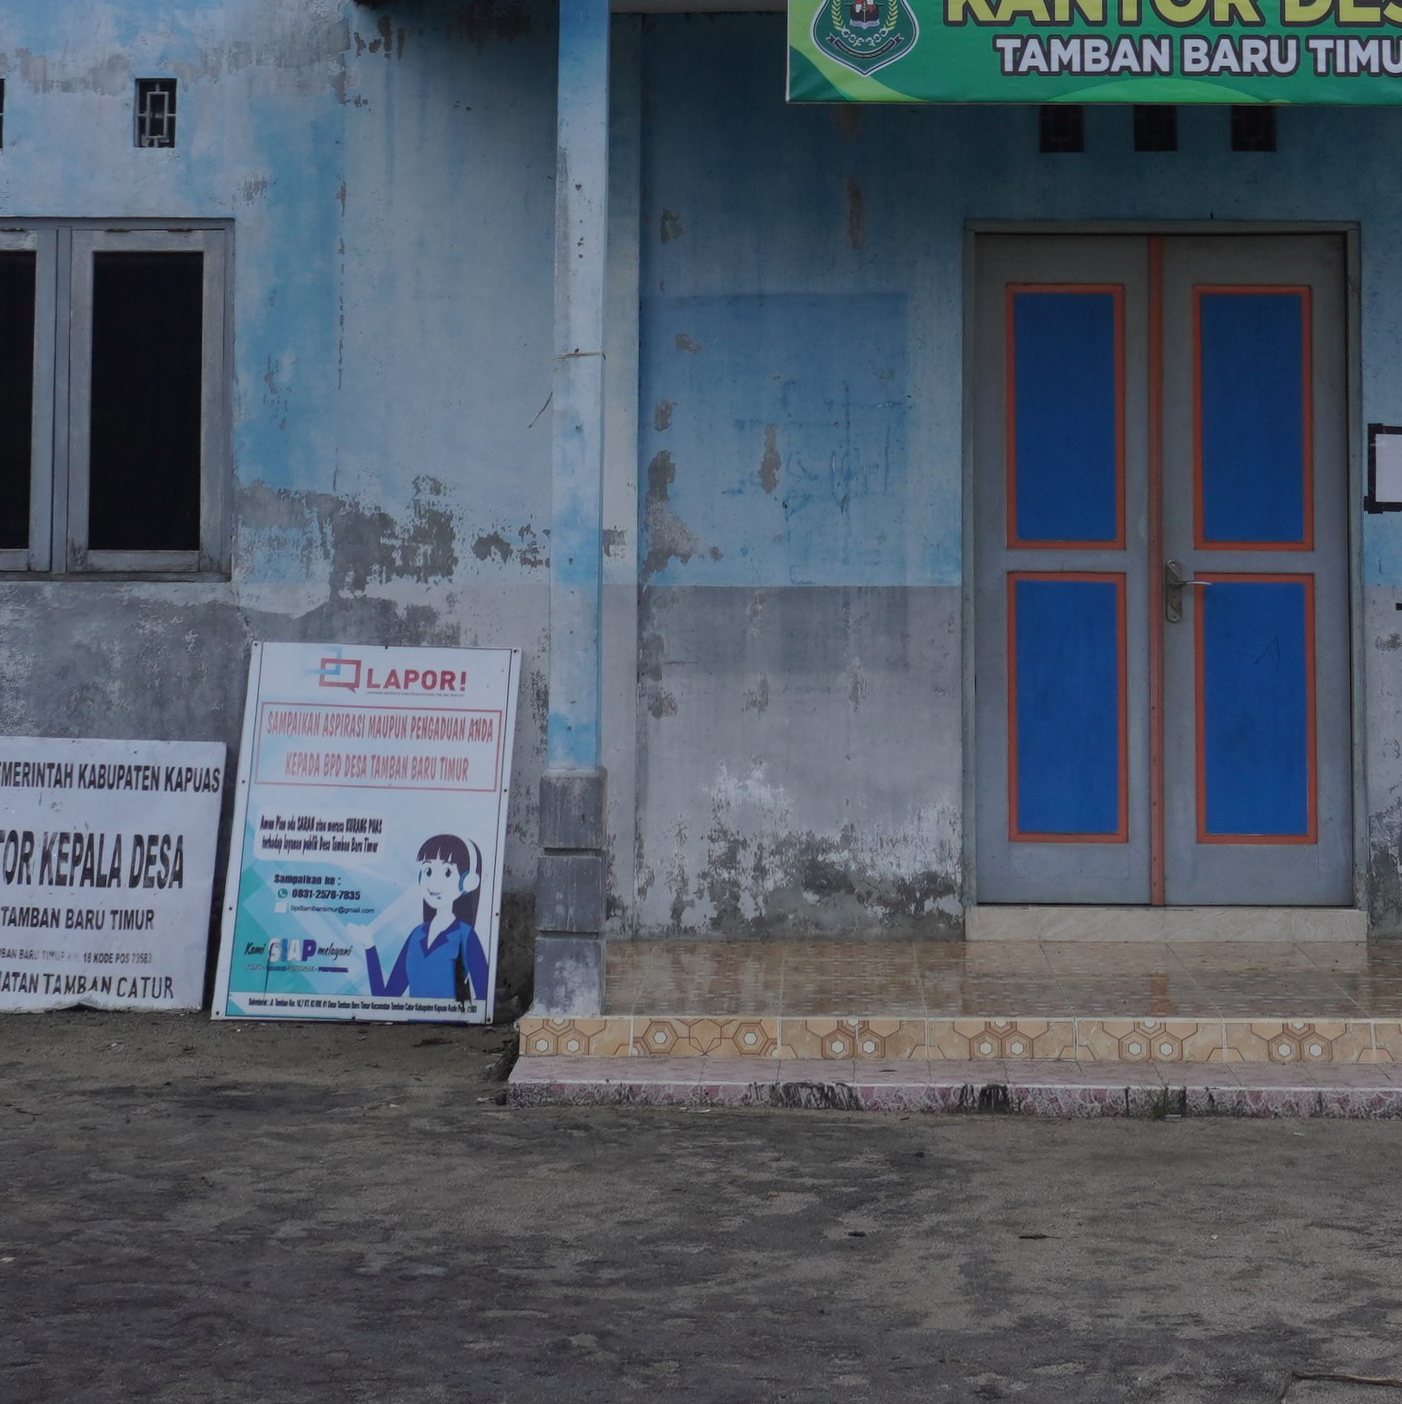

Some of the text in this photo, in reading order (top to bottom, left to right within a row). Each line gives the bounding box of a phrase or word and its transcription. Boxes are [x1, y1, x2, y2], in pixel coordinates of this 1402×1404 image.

[996, 37, 1170, 73] TAMBAN
[1181, 38, 1297, 73] BARU
[366, 668, 467, 692] LAPOR!
[267, 711, 493, 743] SAMPAIKAN ASPIRASI MAUPUN PENGADUAN ANDA
[78, 763, 160, 792] KABUPATEN
[164, 766, 220, 793] KAPUAS
[285, 752, 469, 782] KEPADA BPD DESA TAMBAN BARU TIMUR
[39, 830, 122, 888] KEPALA
[128, 833, 184, 890] DESA
[274, 874, 322, 885] Sampaikan
[1, 905, 60, 929] TAMBAN
[65, 908, 105, 930] BARU
[110, 909, 155, 931] TIMUR
[18, 948, 39, 961] BARU
[83, 951, 92, 963] 18
[93, 952, 114, 964] KODE
[115, 952, 130, 964] POS
[267, 938, 317, 963] SIAP
[43, 972, 112, 996] TAMBAN
[116, 975, 174, 1000] CATUR
